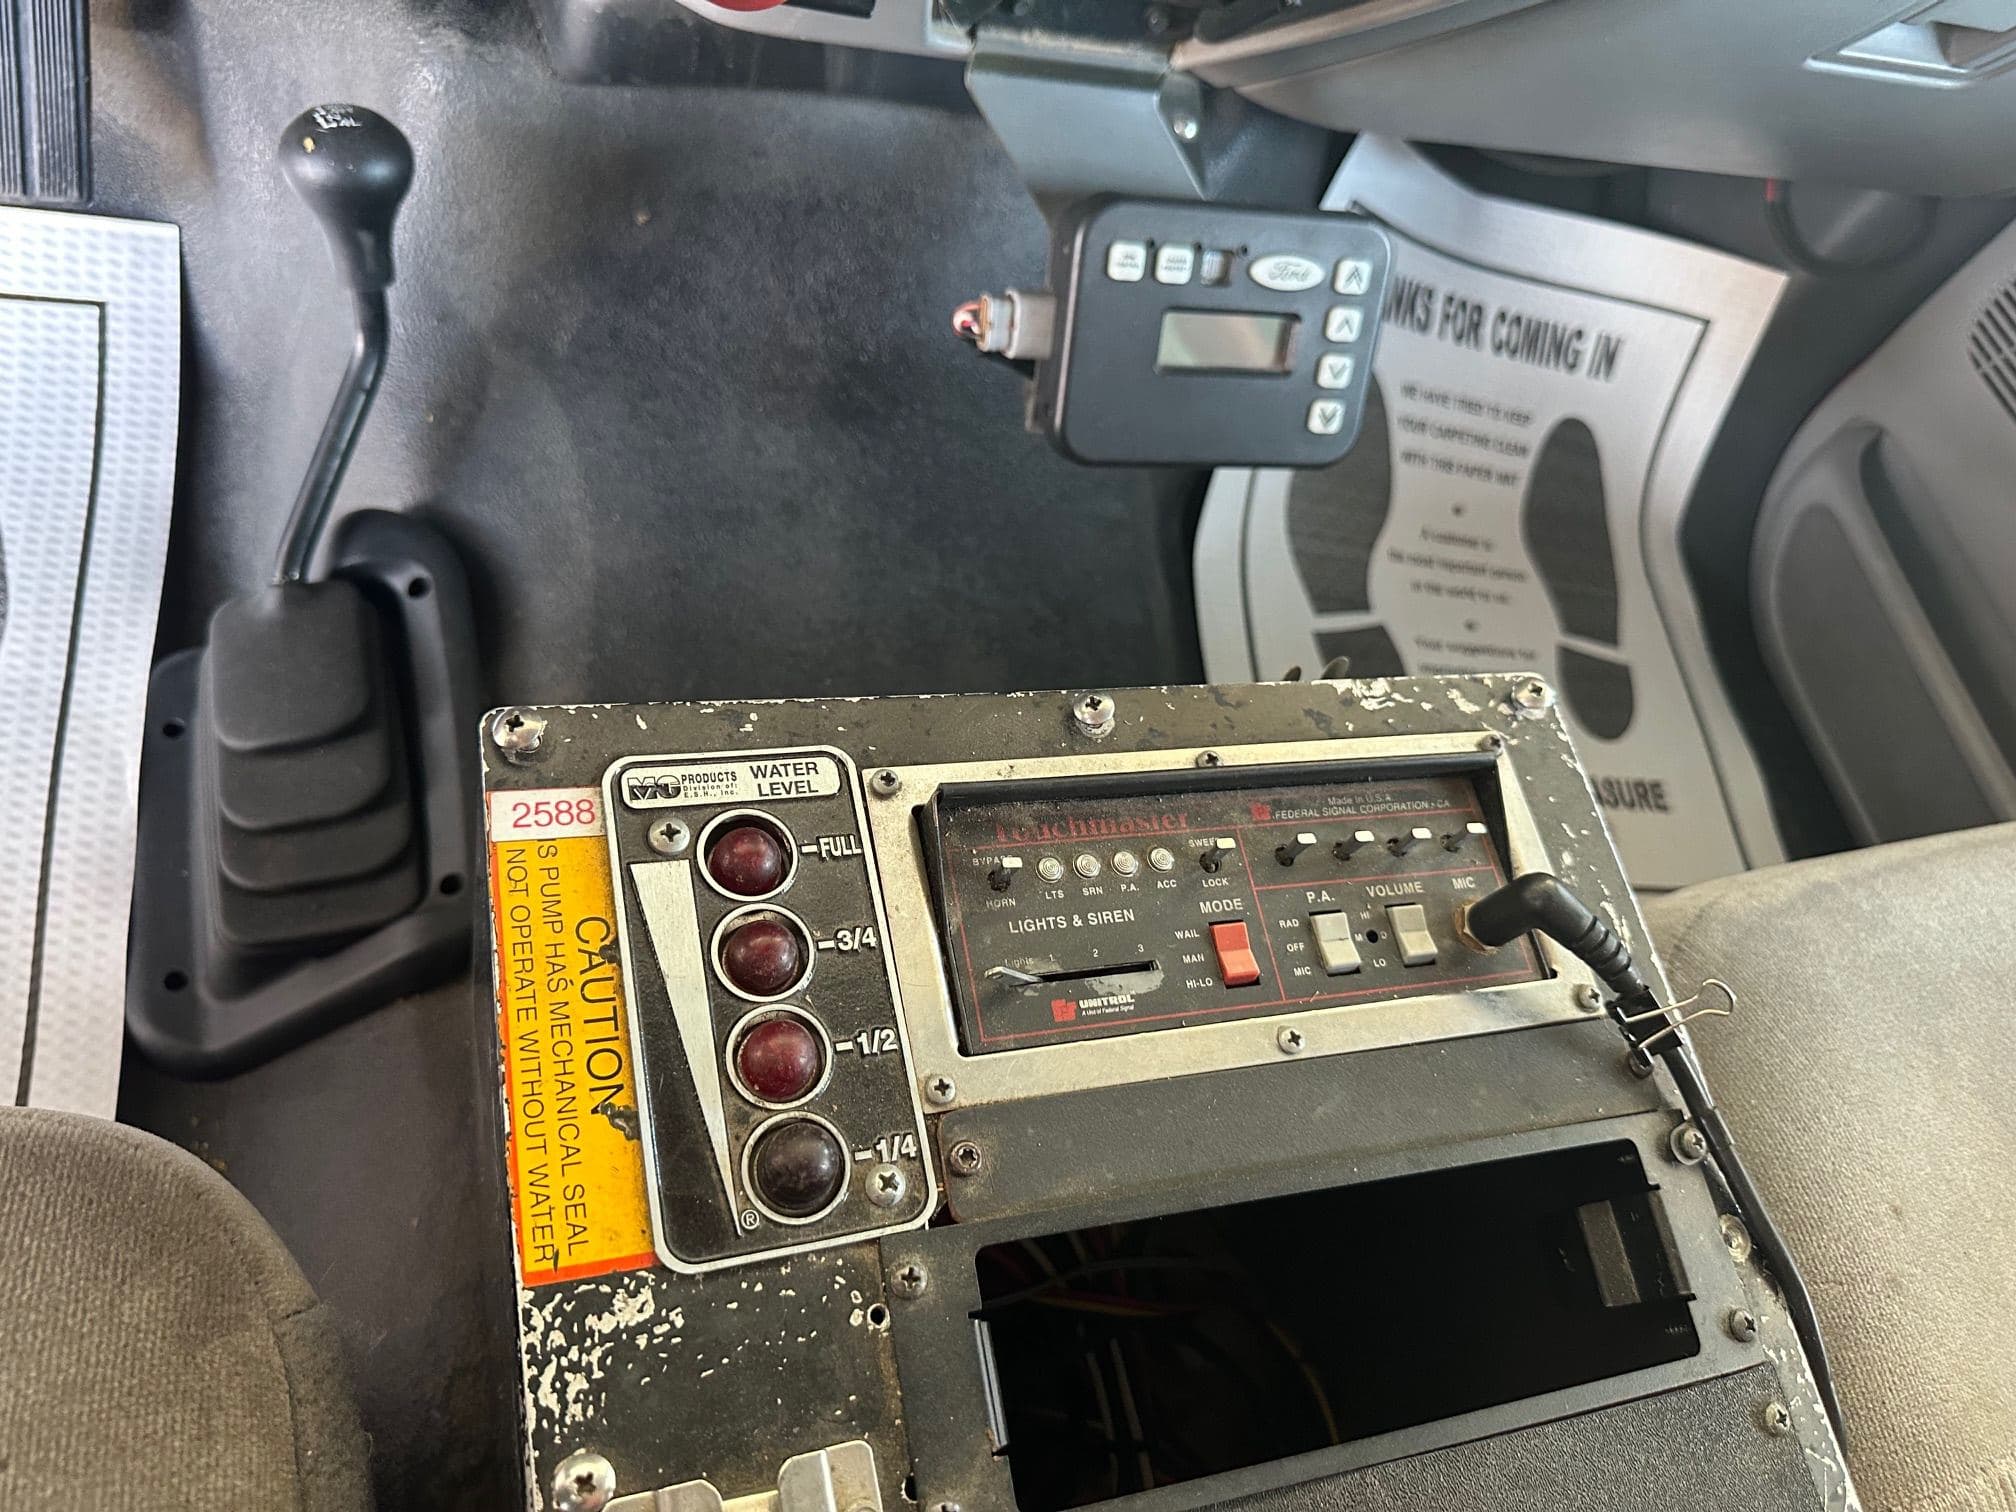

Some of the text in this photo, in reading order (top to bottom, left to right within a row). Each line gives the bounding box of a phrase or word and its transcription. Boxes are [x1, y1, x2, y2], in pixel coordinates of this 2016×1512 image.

[1381, 277, 1623, 381] NKS FOR COMING IN
[750, 761, 819, 780] WATER
[681, 771, 737, 784] PRODUCTS
[683, 784, 721, 792] Division
[757, 780, 819, 797] LEVEL
[1327, 796, 1353, 806] Made
[512, 799, 596, 828] 2588
[1275, 809, 1319, 820] FEDERAL
[1322, 805, 1357, 817] SIGNAL
[1359, 800, 1428, 813] CORPORATION
[818, 835, 862, 858] FULL
[1188, 837, 1219, 848] SWEE
[972, 854, 1012, 866] BYPA
[1120, 882, 1140, 893] P.A.
[1157, 879, 1177, 889] ACC
[1202, 877, 1229, 888] LOCK
[1451, 877, 1476, 890] MIC
[1045, 889, 1064, 899] LTS
[1082, 886, 1103, 896] SRN
[1366, 881, 1425, 898] VOLUME
[539, 867, 564, 934] PUMP
[985, 897, 1016, 909] HORN
[1306, 891, 1336, 904] P.A.
[1200, 898, 1243, 915] MODE
[1008, 909, 1135, 934] LIGHTS & SIREN
[1360, 910, 1370, 920] HI
[1279, 918, 1299, 929] RAD
[836, 927, 877, 950] 3/4
[1174, 929, 1200, 940] WAIL
[1092, 948, 1099, 957] 2
[1137, 944, 1144, 953] 3
[1286, 943, 1305, 952] OFF
[1049, 953, 1056, 962] 1
[1182, 954, 1205, 964] MAN
[1373, 958, 1386, 968] LO
[545, 943, 568, 993] HAS
[1293, 967, 1311, 977] MIC
[1186, 978, 1213, 989] HI-LO
[1079, 994, 1135, 1009] UNITROL
[576, 916, 624, 1114] CAUTION
[856, 1028, 899, 1056] 1/2
[506, 849, 555, 1263] NOT OPERATE WITHOUT WATER
[549, 1001, 582, 1177] MECHANICAL
[876, 1135, 918, 1163] 1/4
[563, 1184, 589, 1257] SEAL
